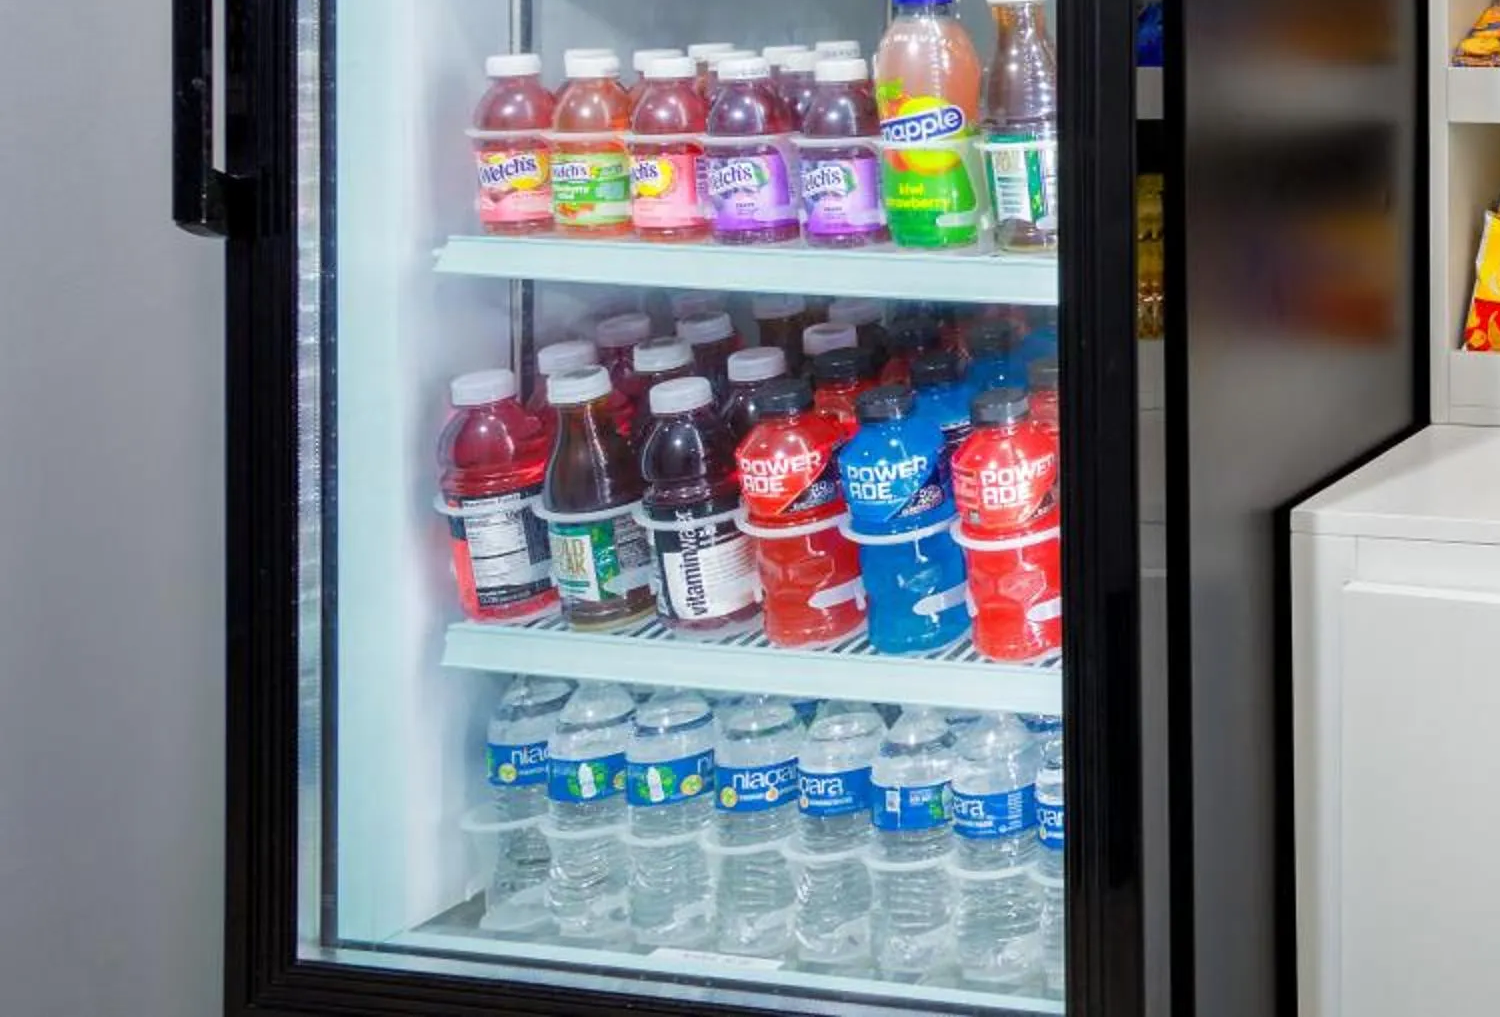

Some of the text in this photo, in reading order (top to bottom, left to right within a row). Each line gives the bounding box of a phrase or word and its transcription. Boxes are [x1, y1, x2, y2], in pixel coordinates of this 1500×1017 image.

[479, 157, 538, 184] Welch's
[740, 451, 821, 476] POWER
[847, 455, 928, 481] POWER
[743, 474, 786, 494] ADE
[849, 482, 893, 501] ADE
